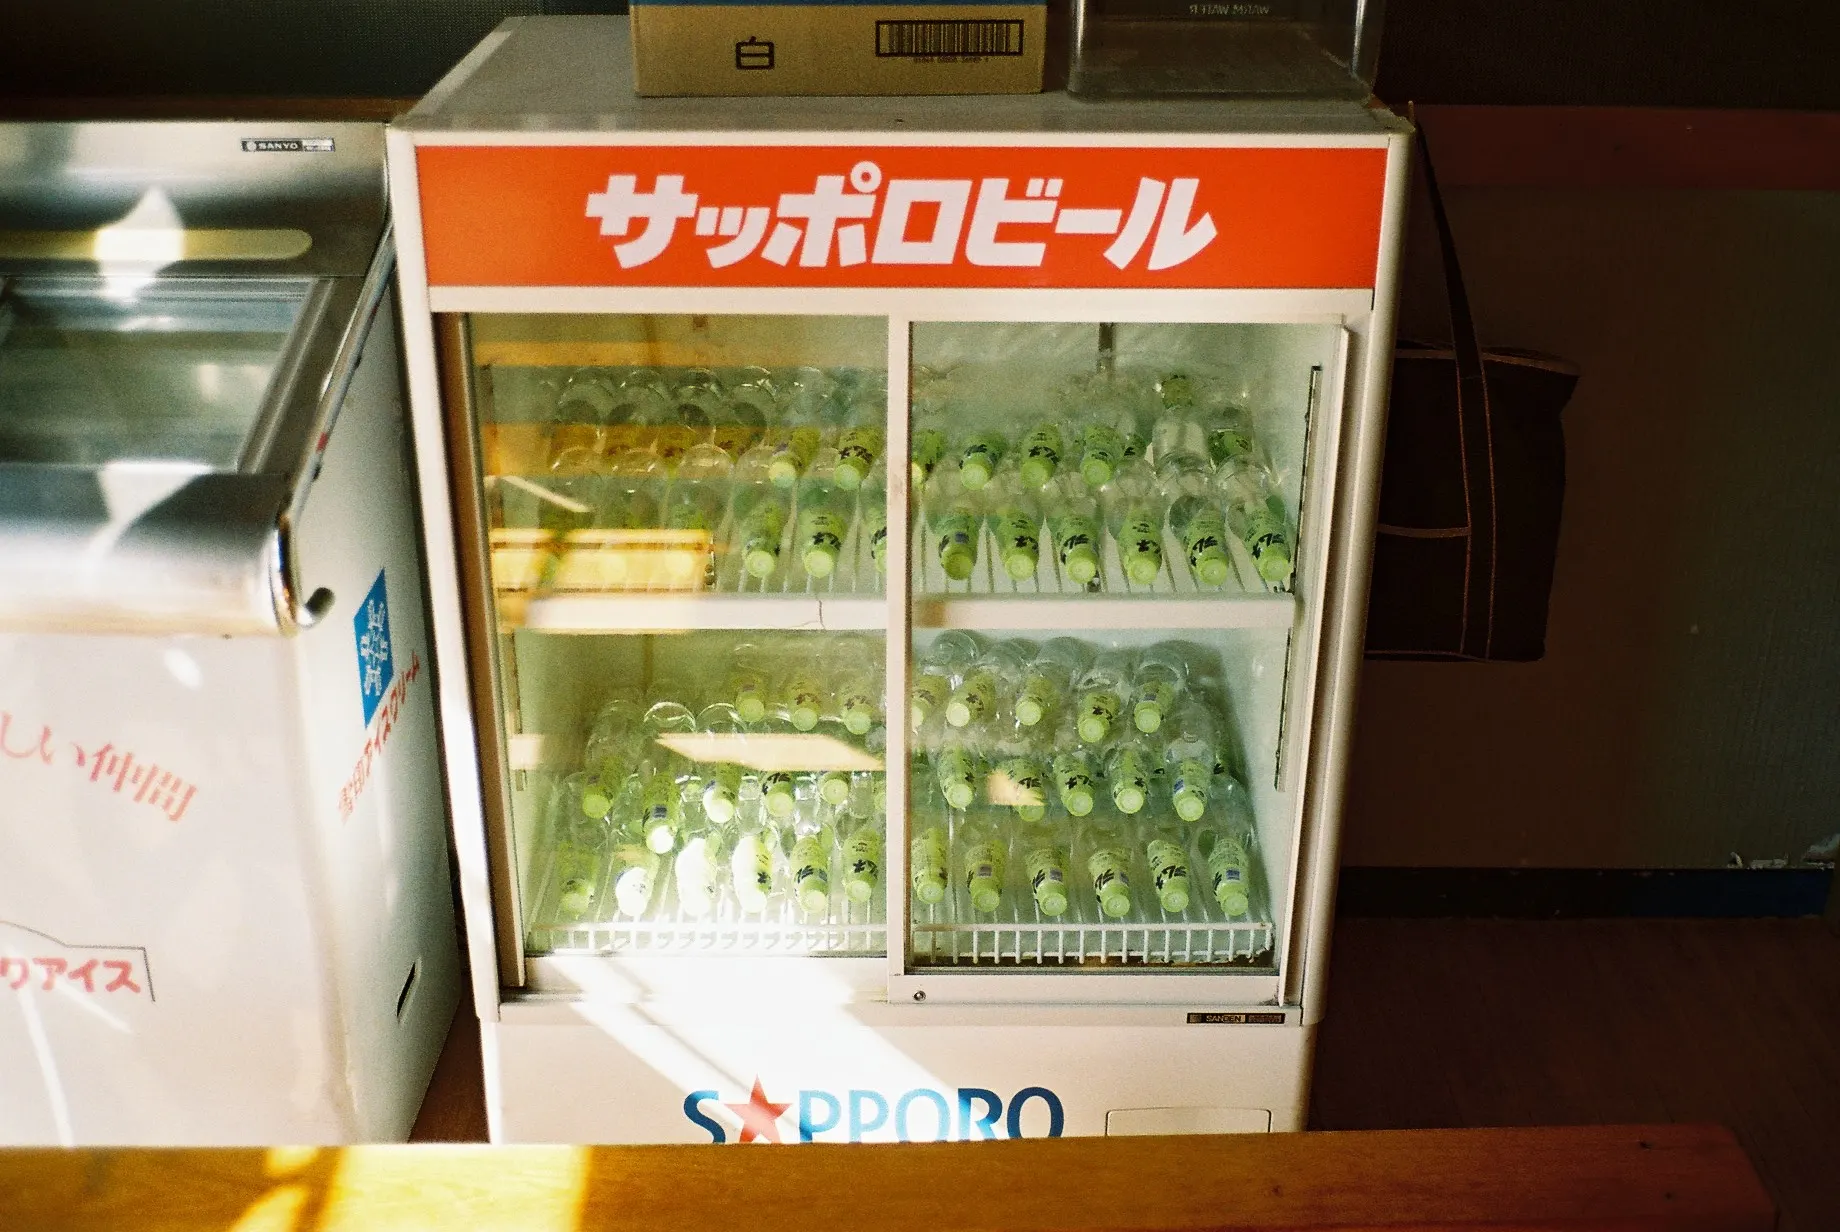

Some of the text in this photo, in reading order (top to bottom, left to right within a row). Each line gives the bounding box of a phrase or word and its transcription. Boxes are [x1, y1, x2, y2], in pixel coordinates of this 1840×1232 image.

[735, 35, 775, 70] 白
[258, 142, 299, 150] SANYO
[585, 161, 1218, 271] サッポロビール
[1205, 1014, 1242, 1023] SANDEN
